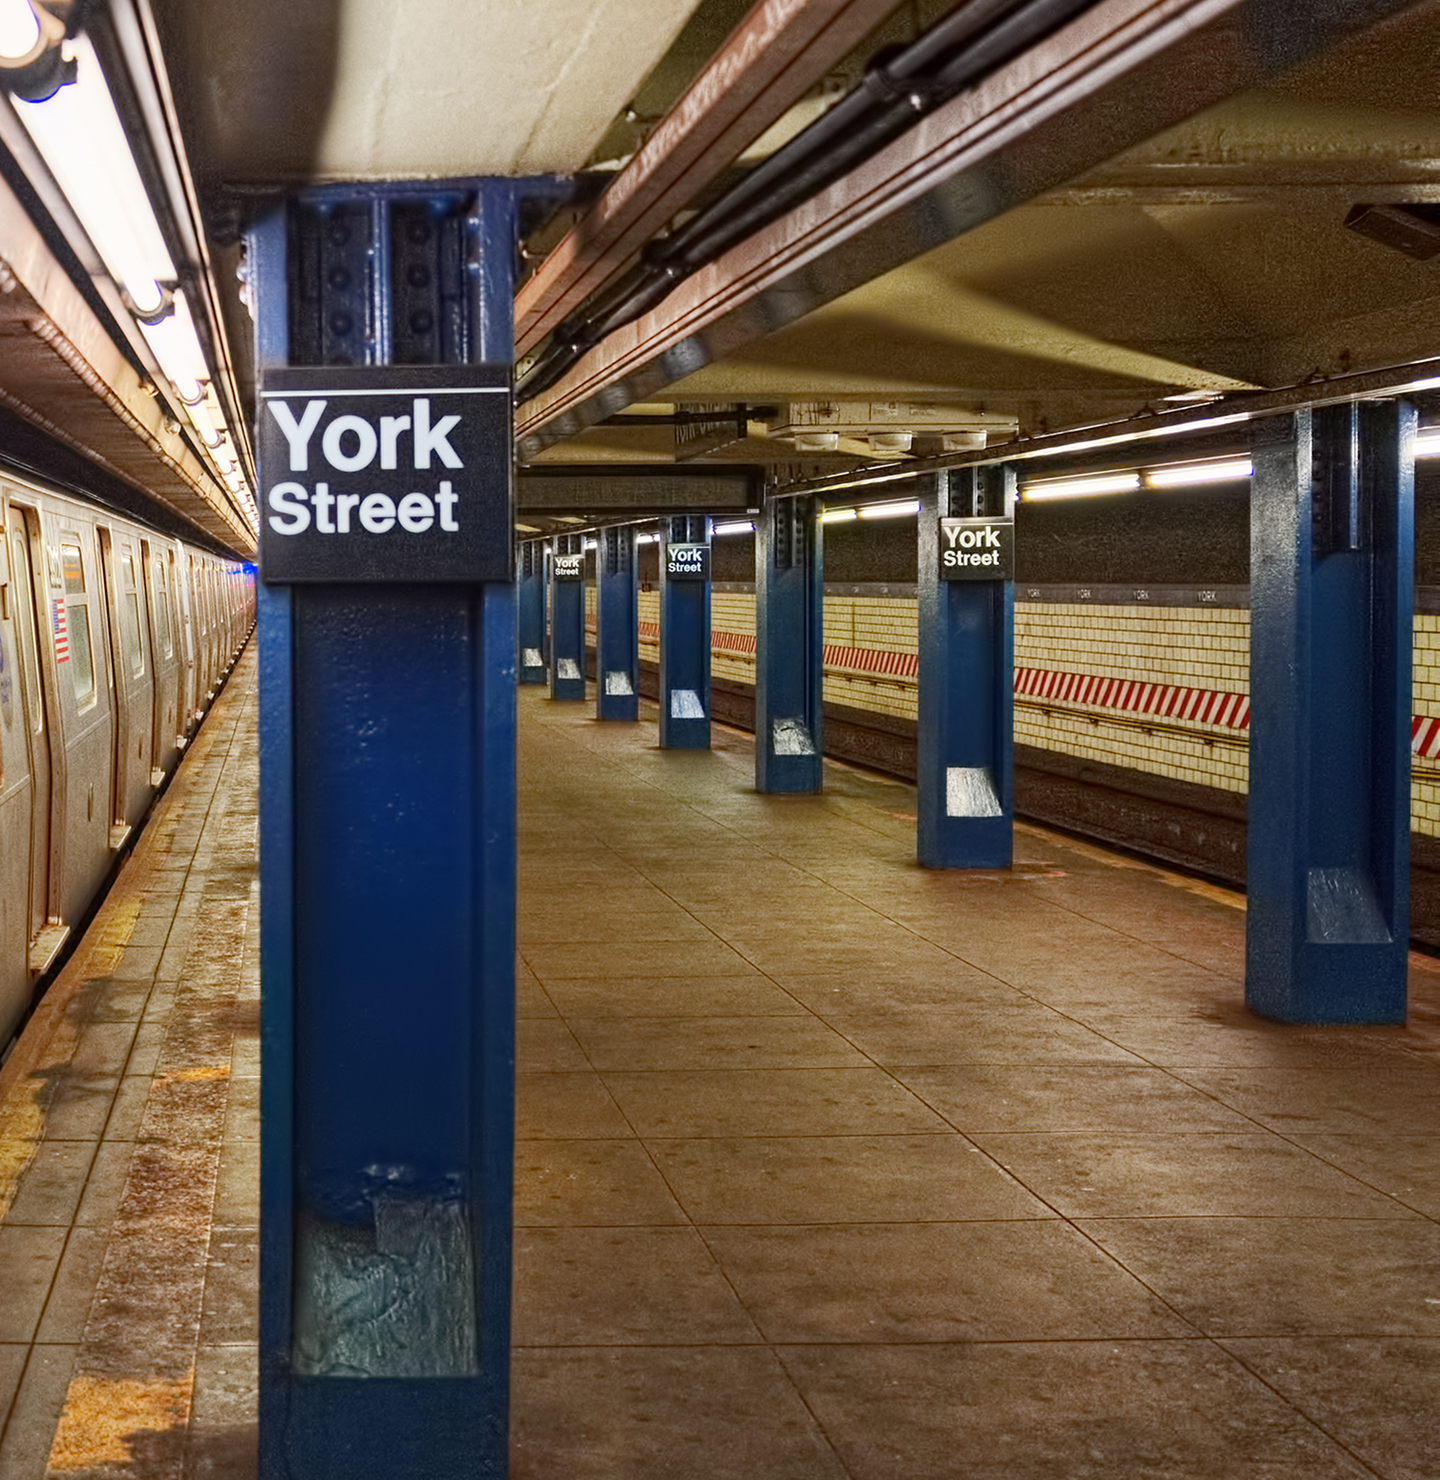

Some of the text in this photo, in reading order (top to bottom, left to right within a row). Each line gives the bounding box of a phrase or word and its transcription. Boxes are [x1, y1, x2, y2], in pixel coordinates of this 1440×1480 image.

[266, 398, 465, 472] York
[268, 480, 460, 536] Street
[943, 525, 1001, 548] York
[555, 557, 580, 568] York
[668, 548, 702, 562] York
[943, 549, 1000, 567] Street
[555, 567, 579, 576] Street
[668, 562, 702, 573] Street
